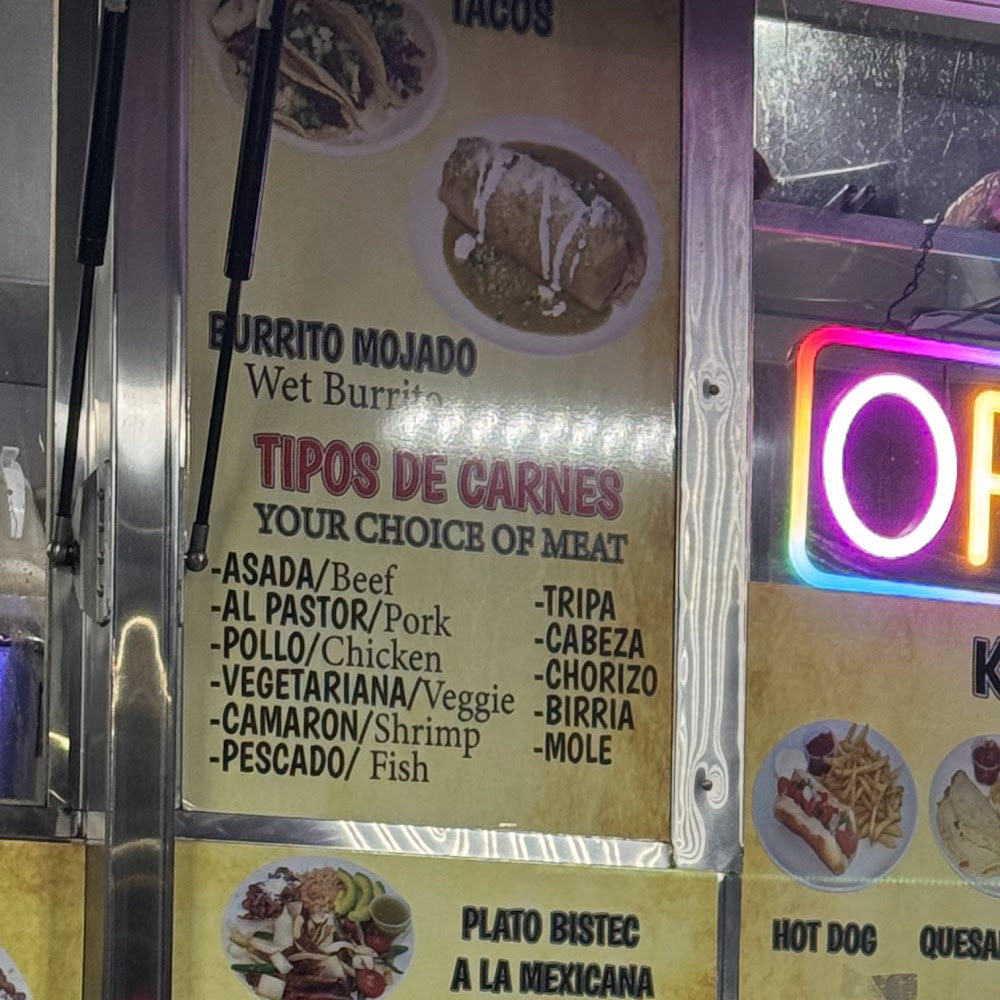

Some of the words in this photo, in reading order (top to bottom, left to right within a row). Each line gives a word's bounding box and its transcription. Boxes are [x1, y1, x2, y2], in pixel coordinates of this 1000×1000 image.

[208, 310, 344, 364] BURRITO
[352, 327, 477, 378] MOJADO
[244, 362, 312, 404] Wet
[323, 370, 445, 411] Burrito
[252, 433, 381, 499] TIPOS
[393, 451, 448, 504] DE
[458, 457, 624, 521] CARNES
[253, 502, 347, 542] YOUR
[354, 513, 485, 553] CHOICE
[491, 524, 535, 557] OF
[541, 528, 629, 564] MEAT
[211, 551, 398, 596] -ASADA/Beef
[211, 590, 256, 622] -AL
[266, 594, 452, 637] PASTOR/Pork
[535, 585, 617, 621] -TRIPA
[211, 626, 443, 674] -POLLO/Chicken
[534, 622, 645, 660] -CABEZA
[211, 664, 516, 723] -VEGETARIANA/Veggie
[534, 659, 659, 697] -CHORIZO
[210, 702, 481, 758] -CAMARON/Shrimp
[534, 694, 635, 732] -BIRRIA
[209, 741, 359, 782] -PESCADO/
[370, 751, 430, 783] Fish
[533, 732, 613, 765] -MOLE
[462, 905, 543, 944] PLATO
[549, 910, 641, 949] BISTEC
[771, 918, 820, 954] HOT
[827, 920, 878, 956] DOG
[450, 956, 472, 992] A
[479, 957, 513, 994] LA
[518, 960, 655, 1000] MEXICANA
